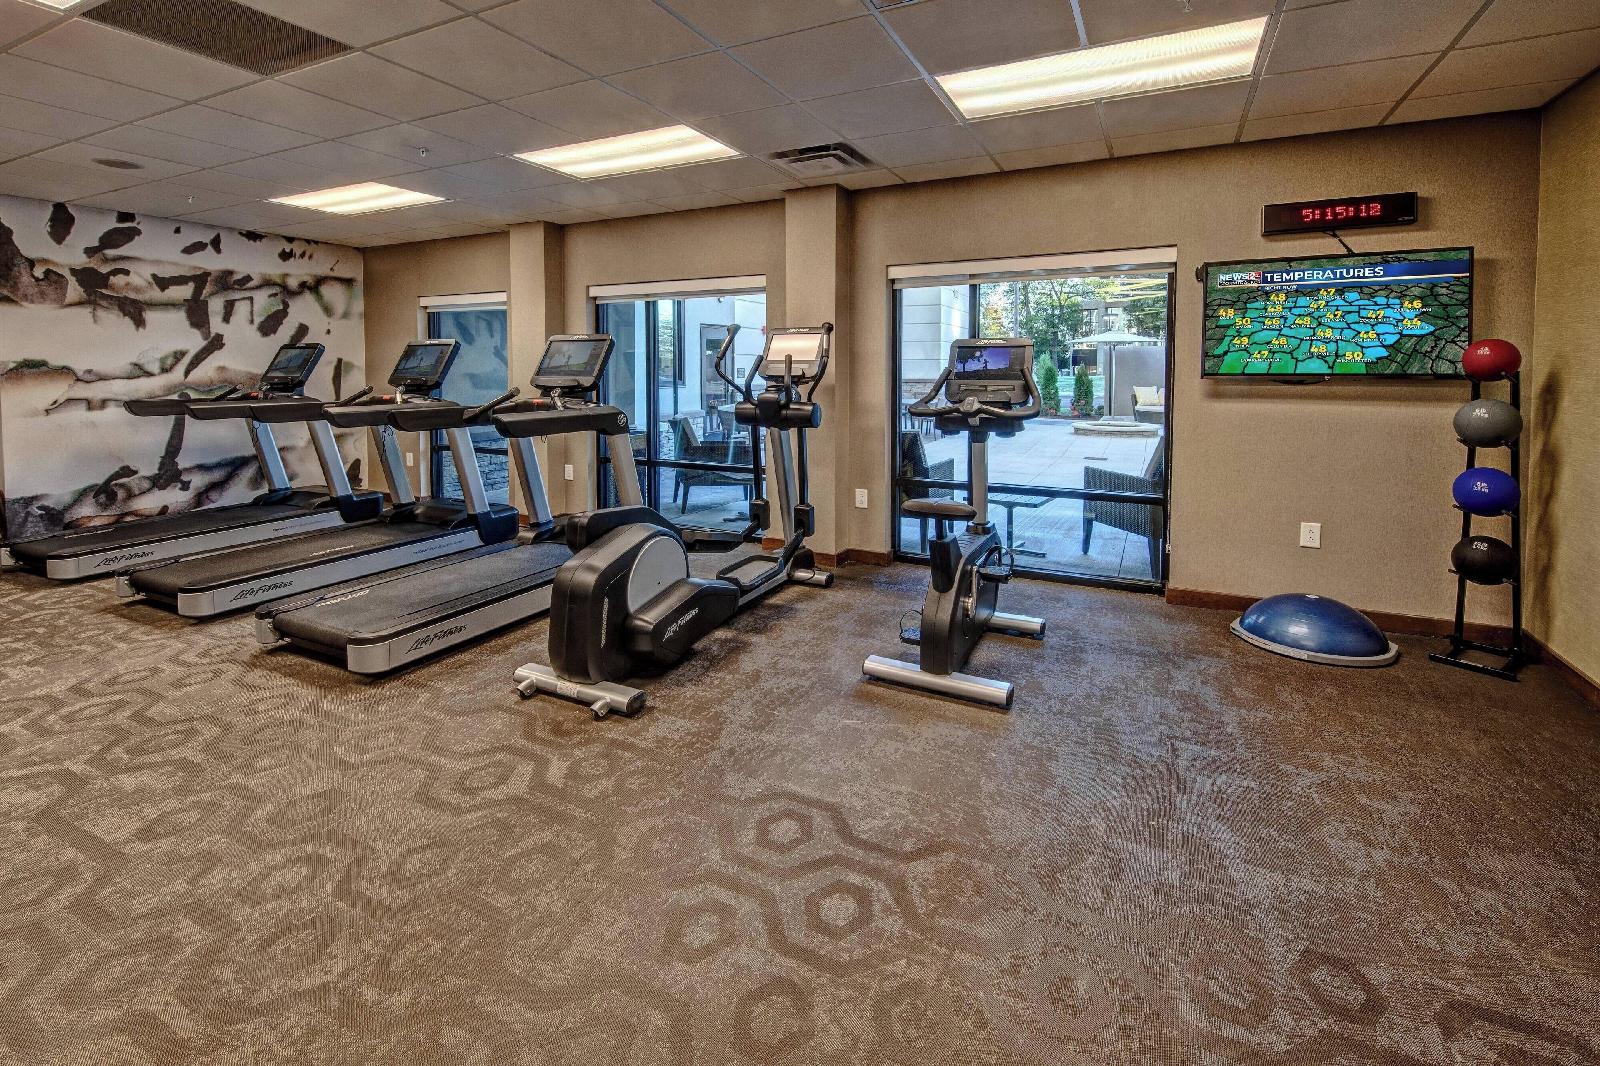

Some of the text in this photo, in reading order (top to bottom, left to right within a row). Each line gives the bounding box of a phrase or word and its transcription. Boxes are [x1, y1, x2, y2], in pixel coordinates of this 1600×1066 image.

[1264, 266, 1384, 282] TEMPERATURES
[1269, 293, 1286, 302] 48
[1235, 317, 1251, 326] 50
[1344, 351, 1363, 360] 50
